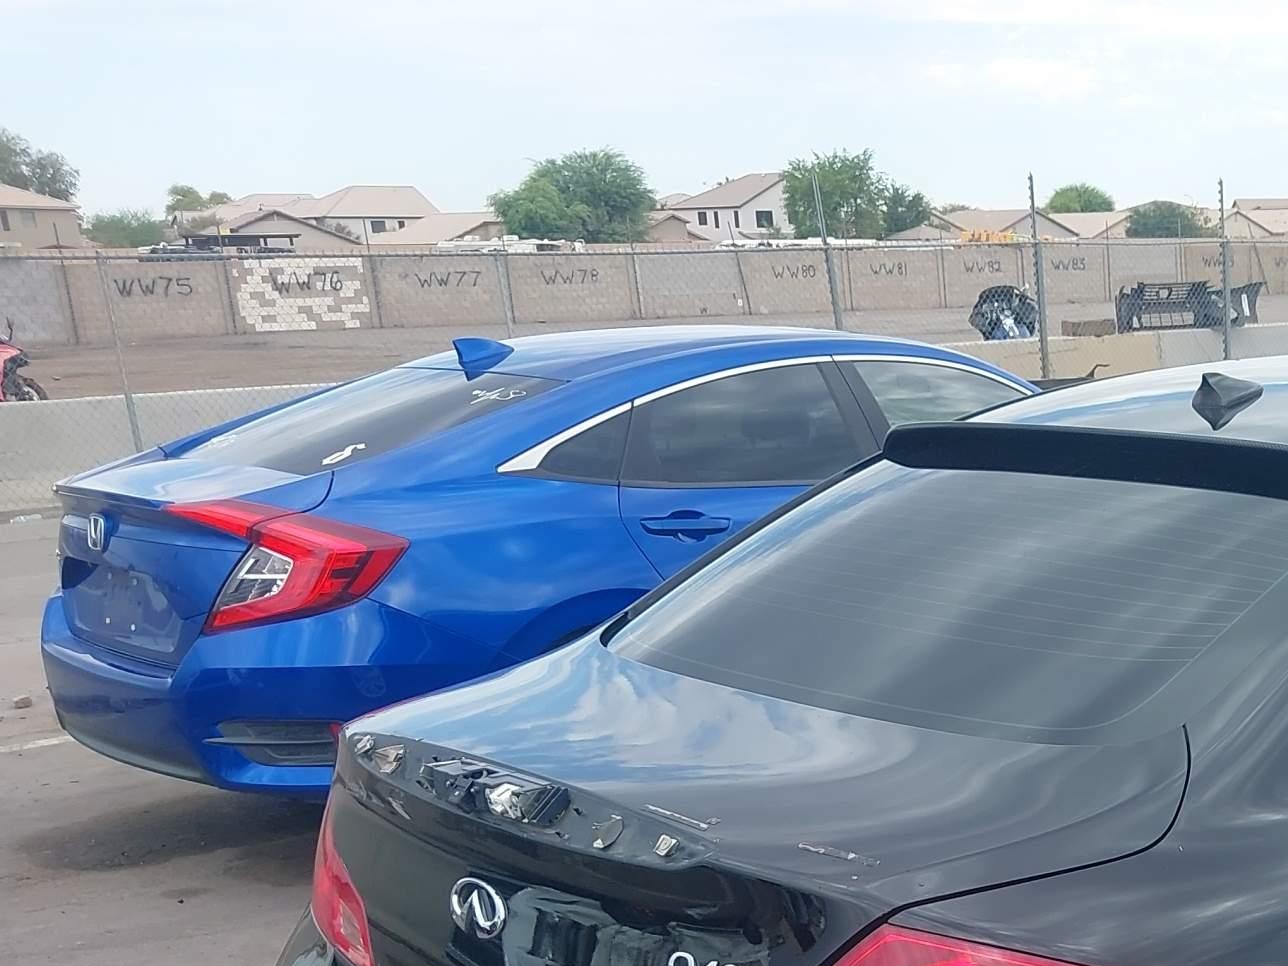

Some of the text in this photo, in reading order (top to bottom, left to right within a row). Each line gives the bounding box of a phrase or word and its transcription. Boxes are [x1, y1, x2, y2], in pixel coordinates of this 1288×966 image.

[772, 264, 816, 279] WW80
[869, 262, 908, 277] WW81
[963, 257, 1001, 273] WW82
[271, 271, 342, 293] WW76
[414, 271, 481, 288] WW77
[540, 268, 600, 285] WW78
[113, 277, 193, 297] WW75
